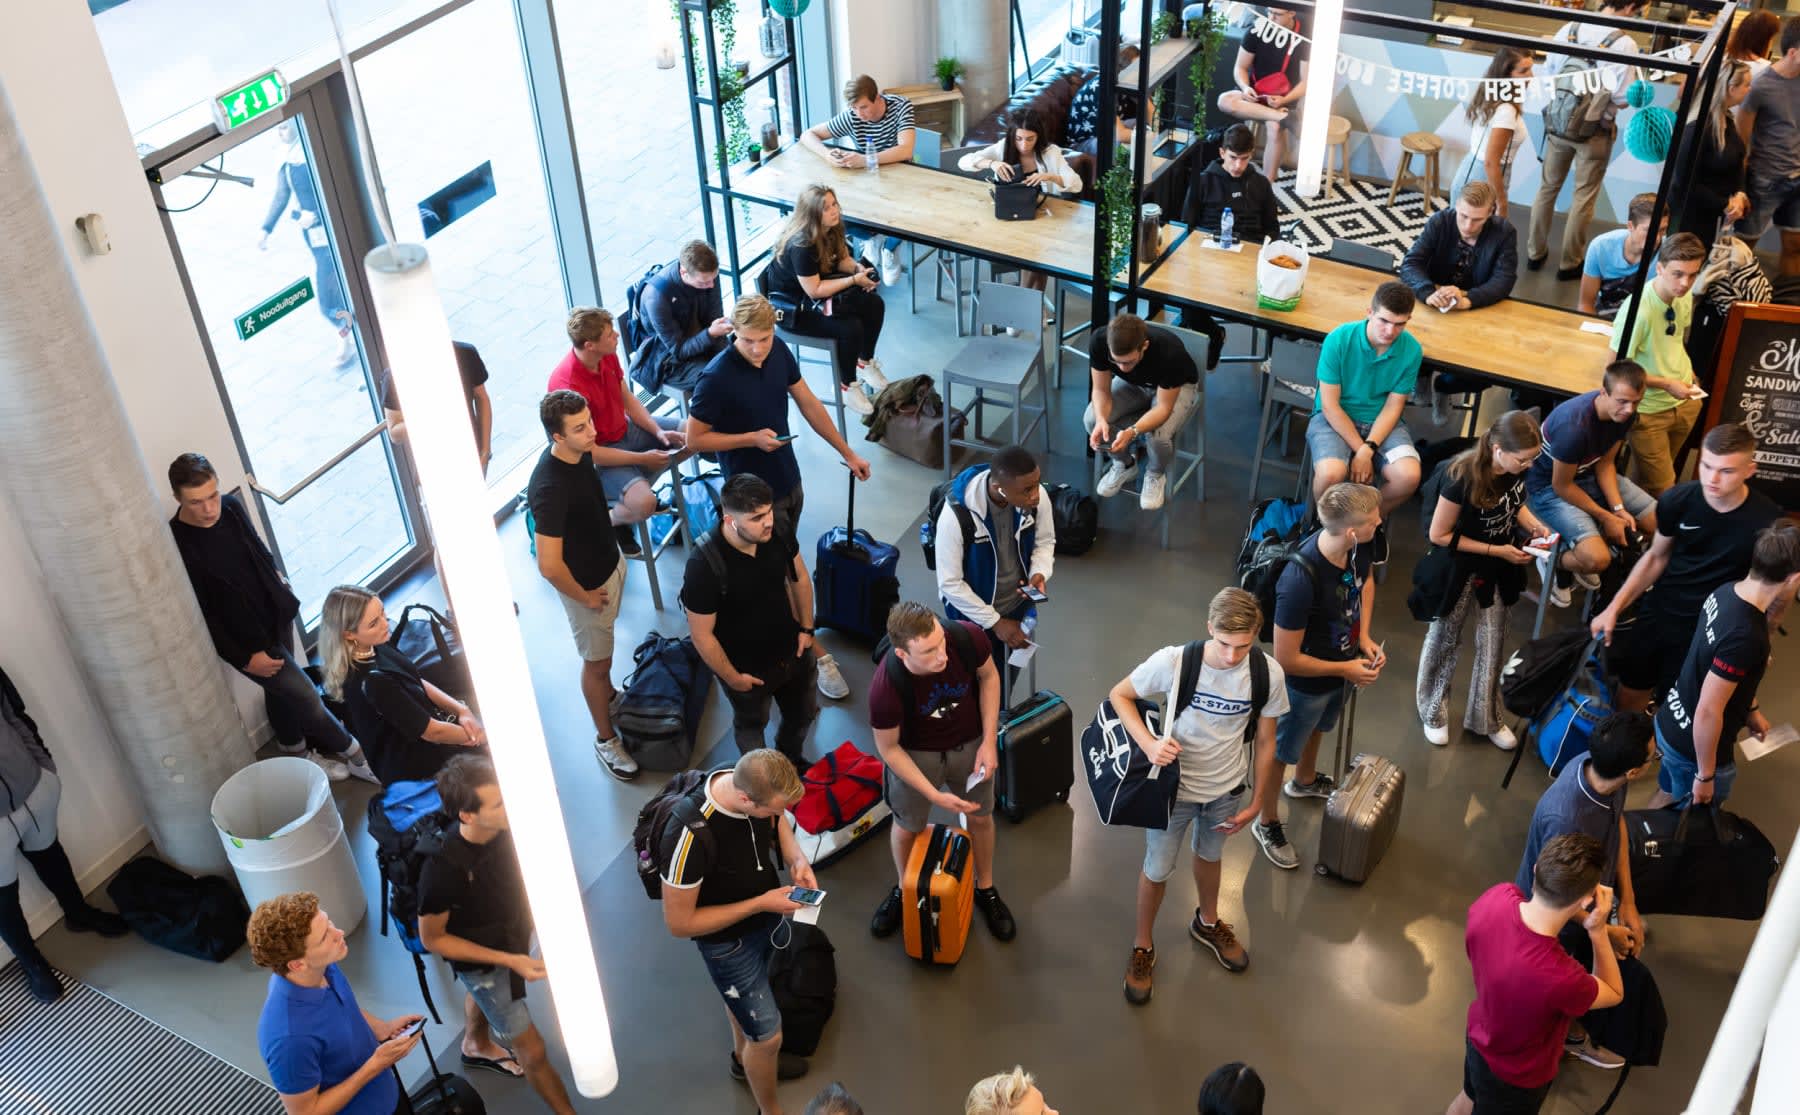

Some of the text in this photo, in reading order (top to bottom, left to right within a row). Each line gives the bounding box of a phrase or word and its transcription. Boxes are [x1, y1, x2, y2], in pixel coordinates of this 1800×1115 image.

[259, 288, 308, 322] Nooduitgang
[1759, 453, 1800, 465] APPET
[1192, 696, 1241, 711] G-STAR
